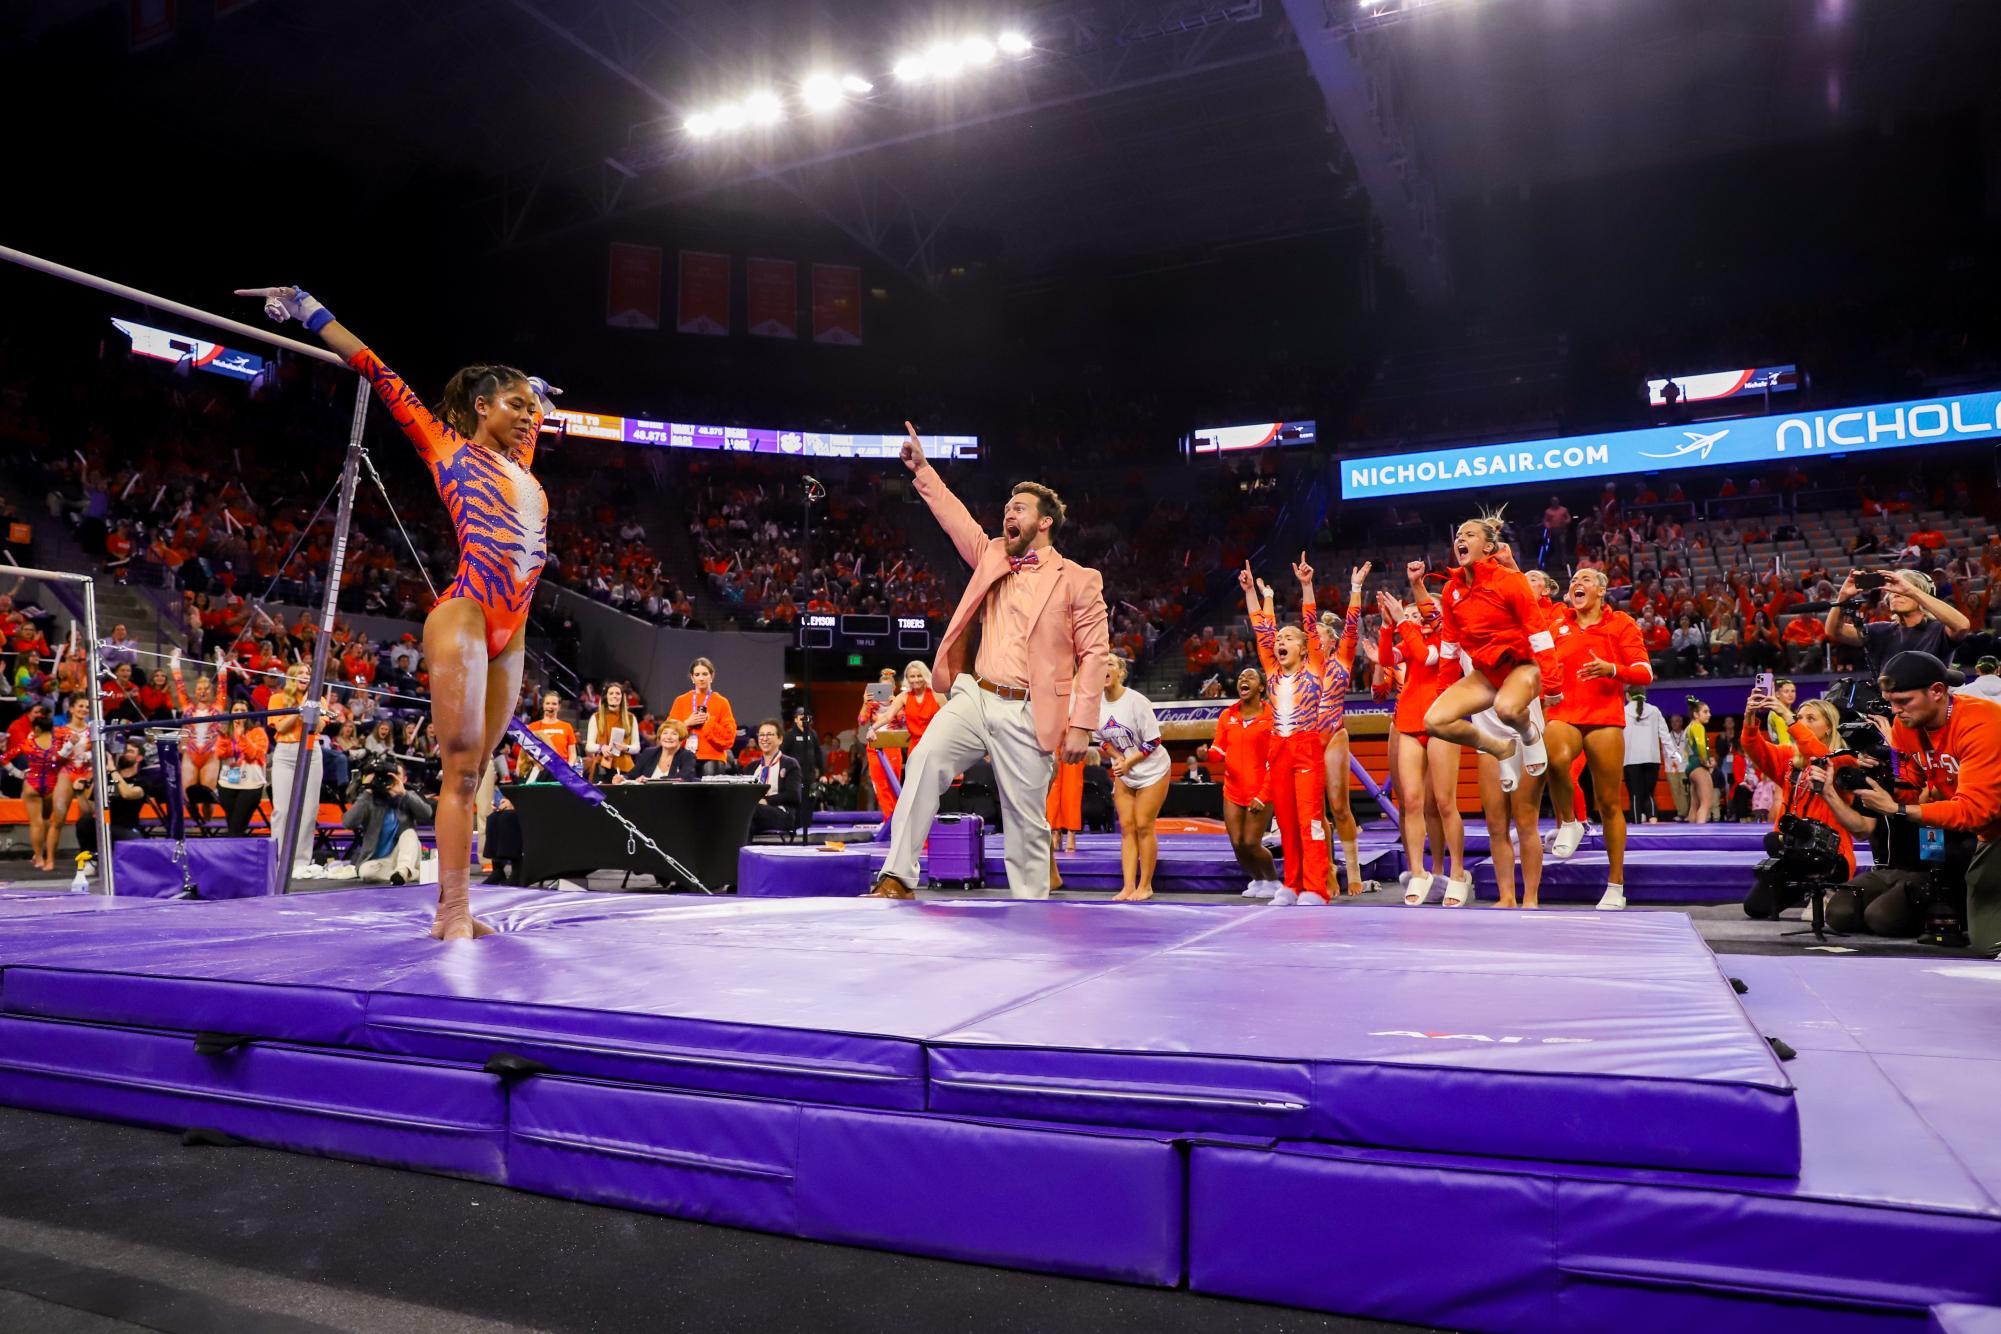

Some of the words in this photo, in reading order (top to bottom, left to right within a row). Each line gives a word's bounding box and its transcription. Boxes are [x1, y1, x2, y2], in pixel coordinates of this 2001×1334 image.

[1776, 400, 2001, 452] NICHOL
[1351, 444, 1609, 488] NICHOLASAIR.COM
[898, 618, 925, 629] TIGERS
